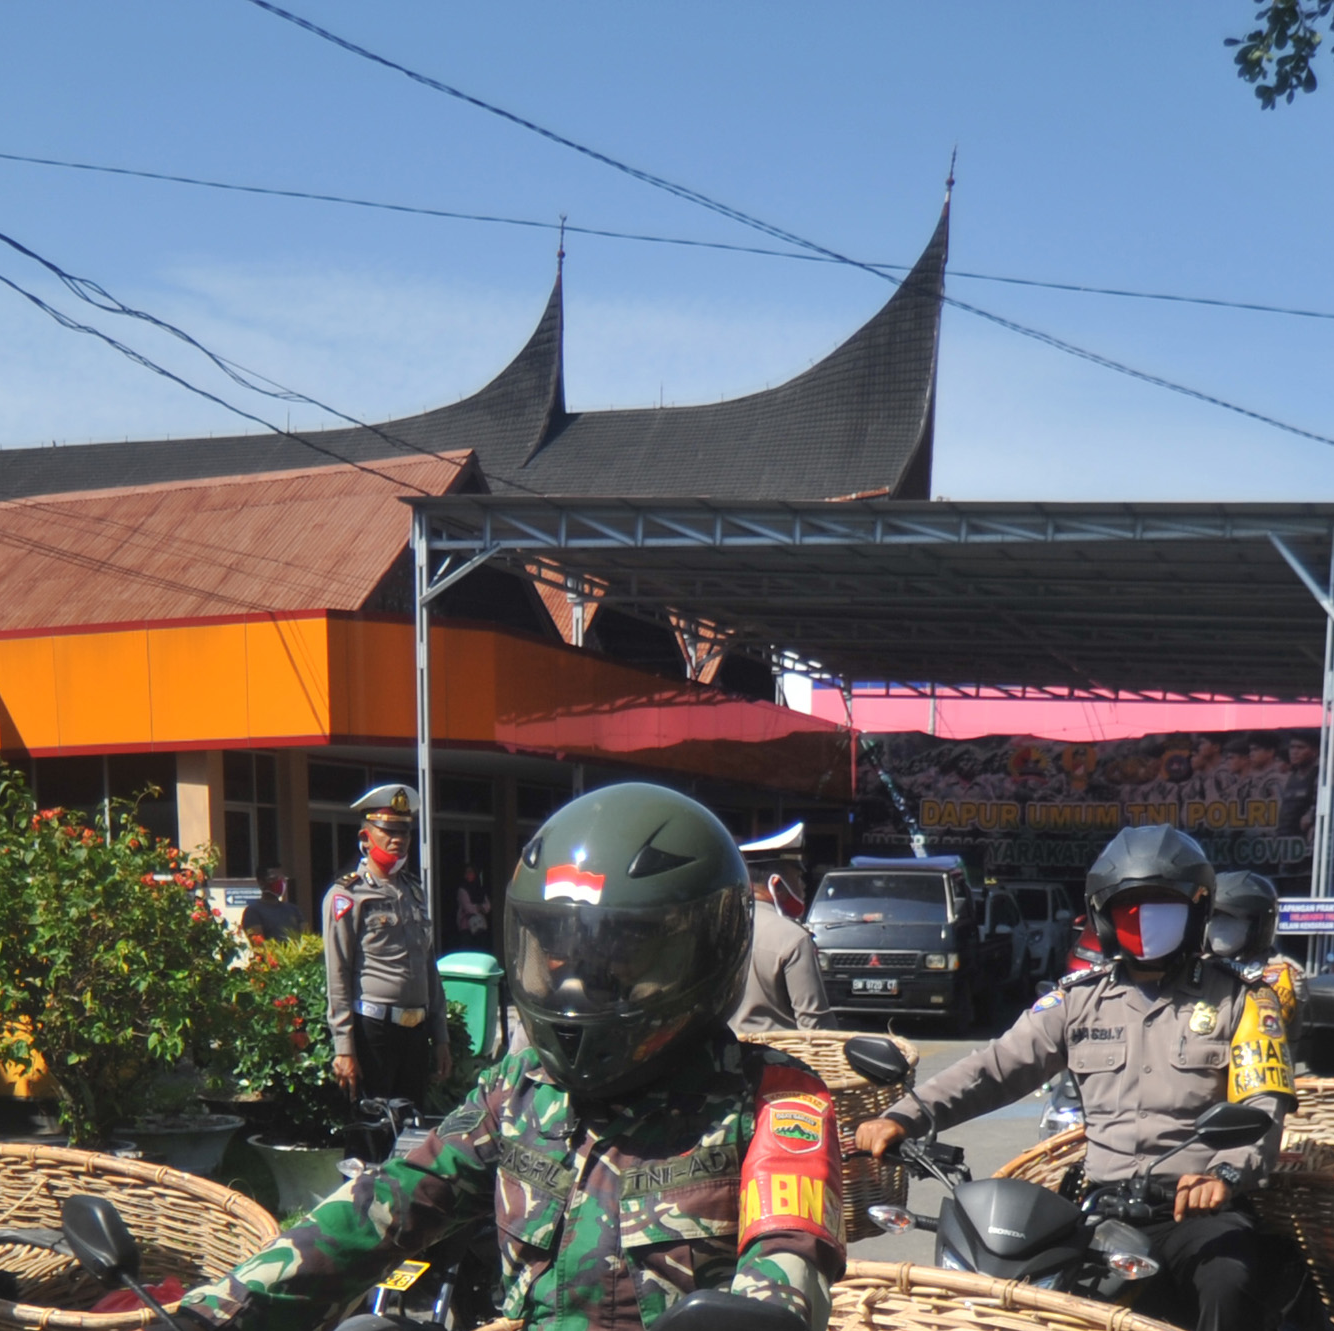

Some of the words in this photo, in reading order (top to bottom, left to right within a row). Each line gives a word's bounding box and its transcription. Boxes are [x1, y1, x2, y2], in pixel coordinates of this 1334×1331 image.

[920, 799, 1019, 830] DAPUR
[1027, 802, 1120, 832] UMUM
[1126, 802, 1178, 829] TNI
[1186, 800, 1280, 830] POLRI
[626, 1150, 729, 1190] TNI-AD
[987, 1226, 1026, 1240] HONDA
